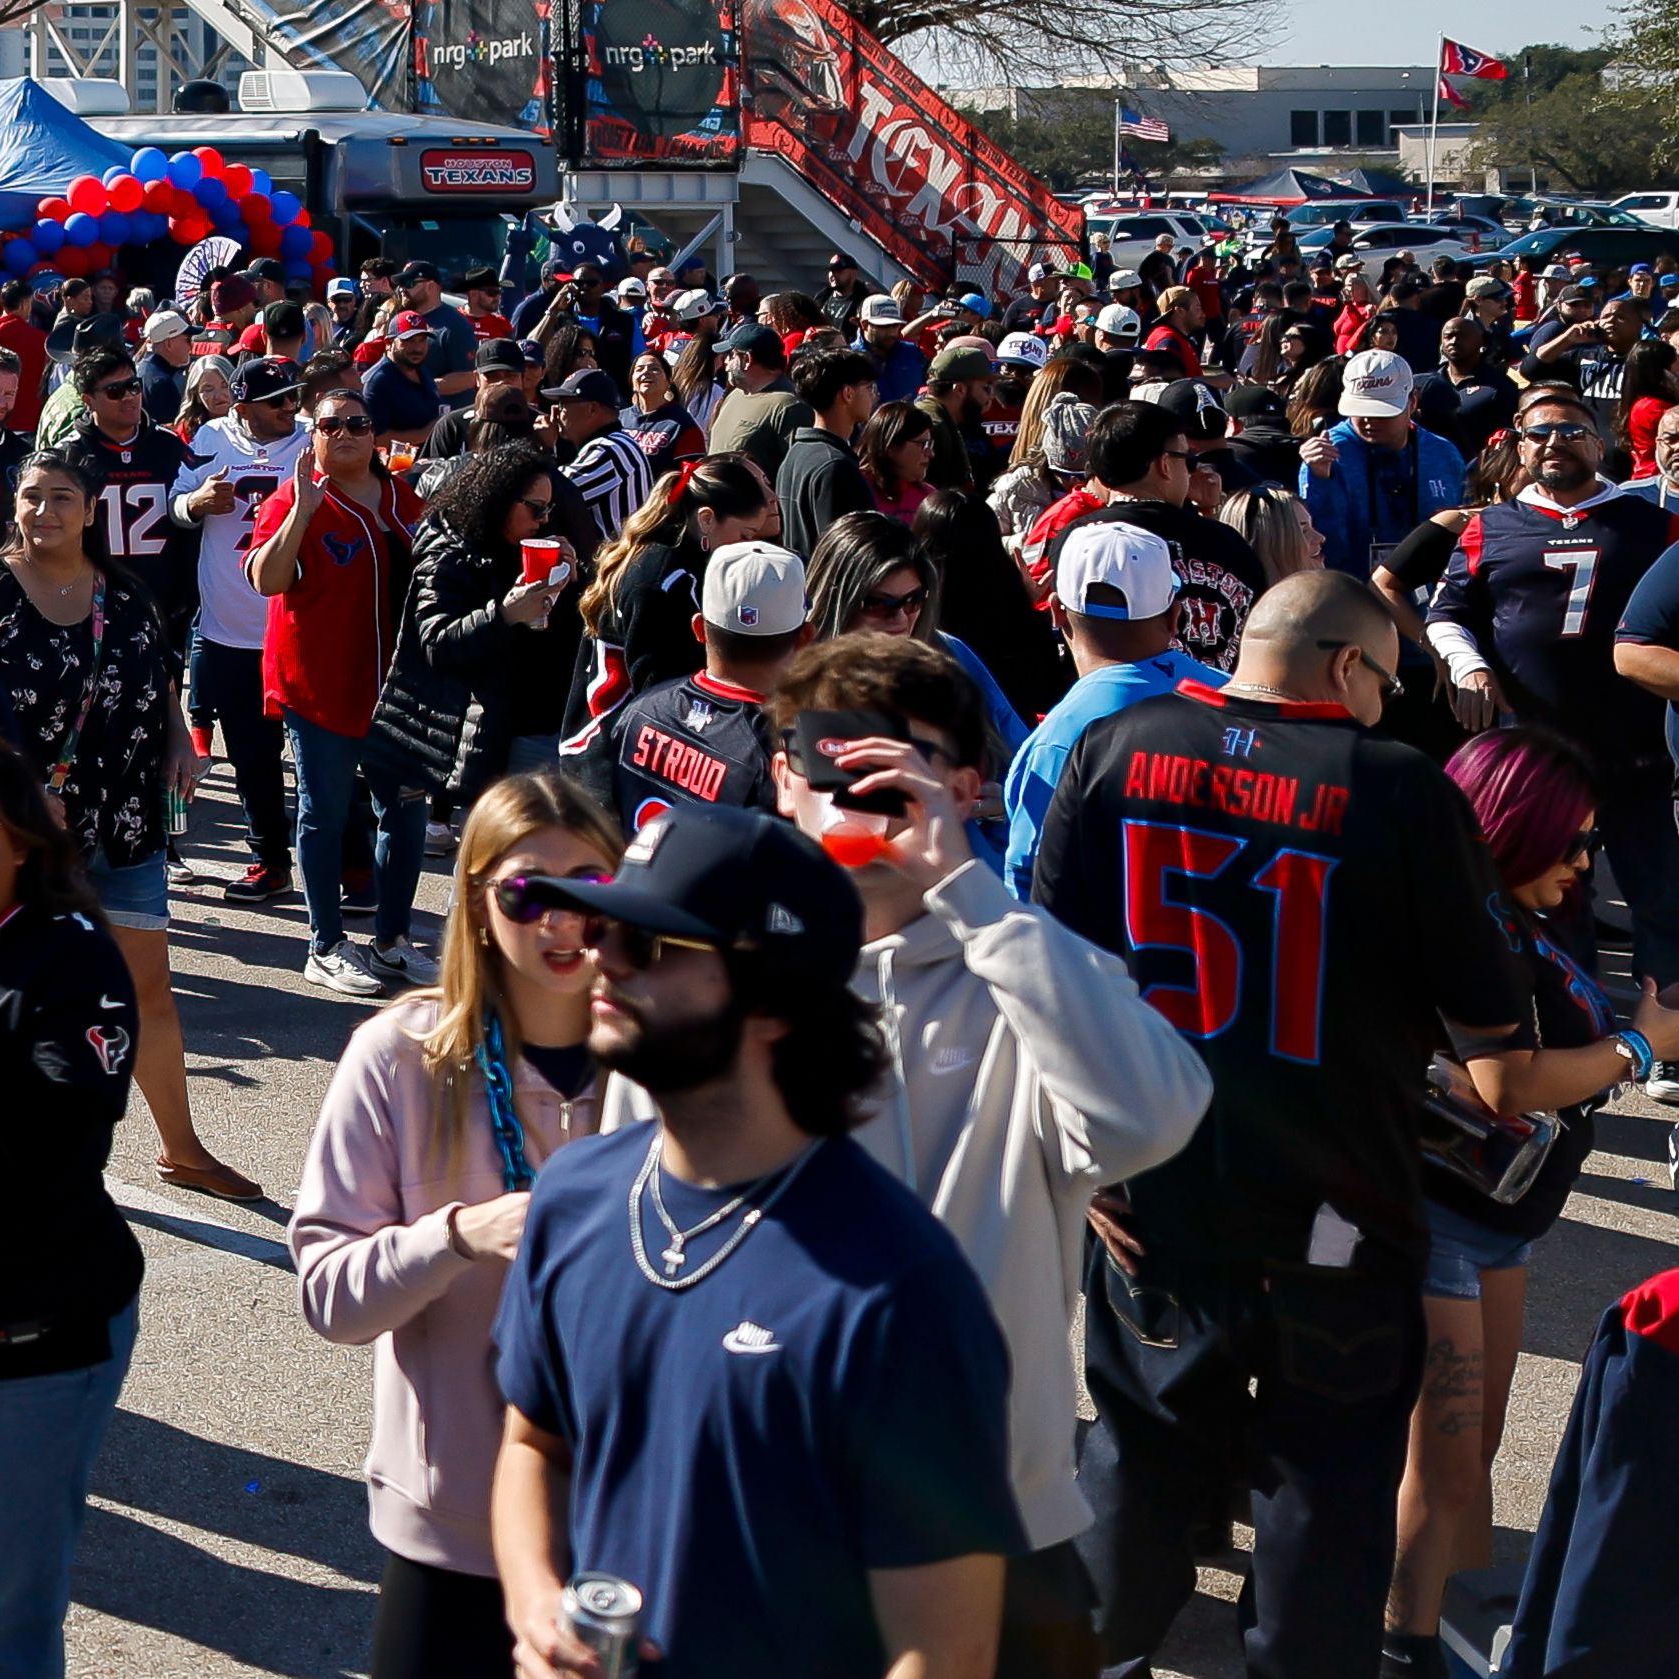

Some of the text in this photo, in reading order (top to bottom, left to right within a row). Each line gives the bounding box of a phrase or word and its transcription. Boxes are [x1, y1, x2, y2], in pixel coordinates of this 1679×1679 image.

[433, 31, 534, 71] nrg park
[604, 40, 716, 72] nrg park
[424, 166, 533, 185] TEXANS
[443, 158, 513, 169] HOUSTON
[1007, 338, 1043, 358] TEXANS
[1349, 374, 1394, 393] Texans
[981, 420, 1021, 436] TEXA
[98, 482, 168, 557] 12
[1546, 537, 1594, 547] TEXANS
[1543, 549, 1599, 637] 7
[632, 724, 729, 803] STROUD
[1124, 750, 1350, 837] ANDERSON JR
[1122, 817, 1340, 1065] 51
